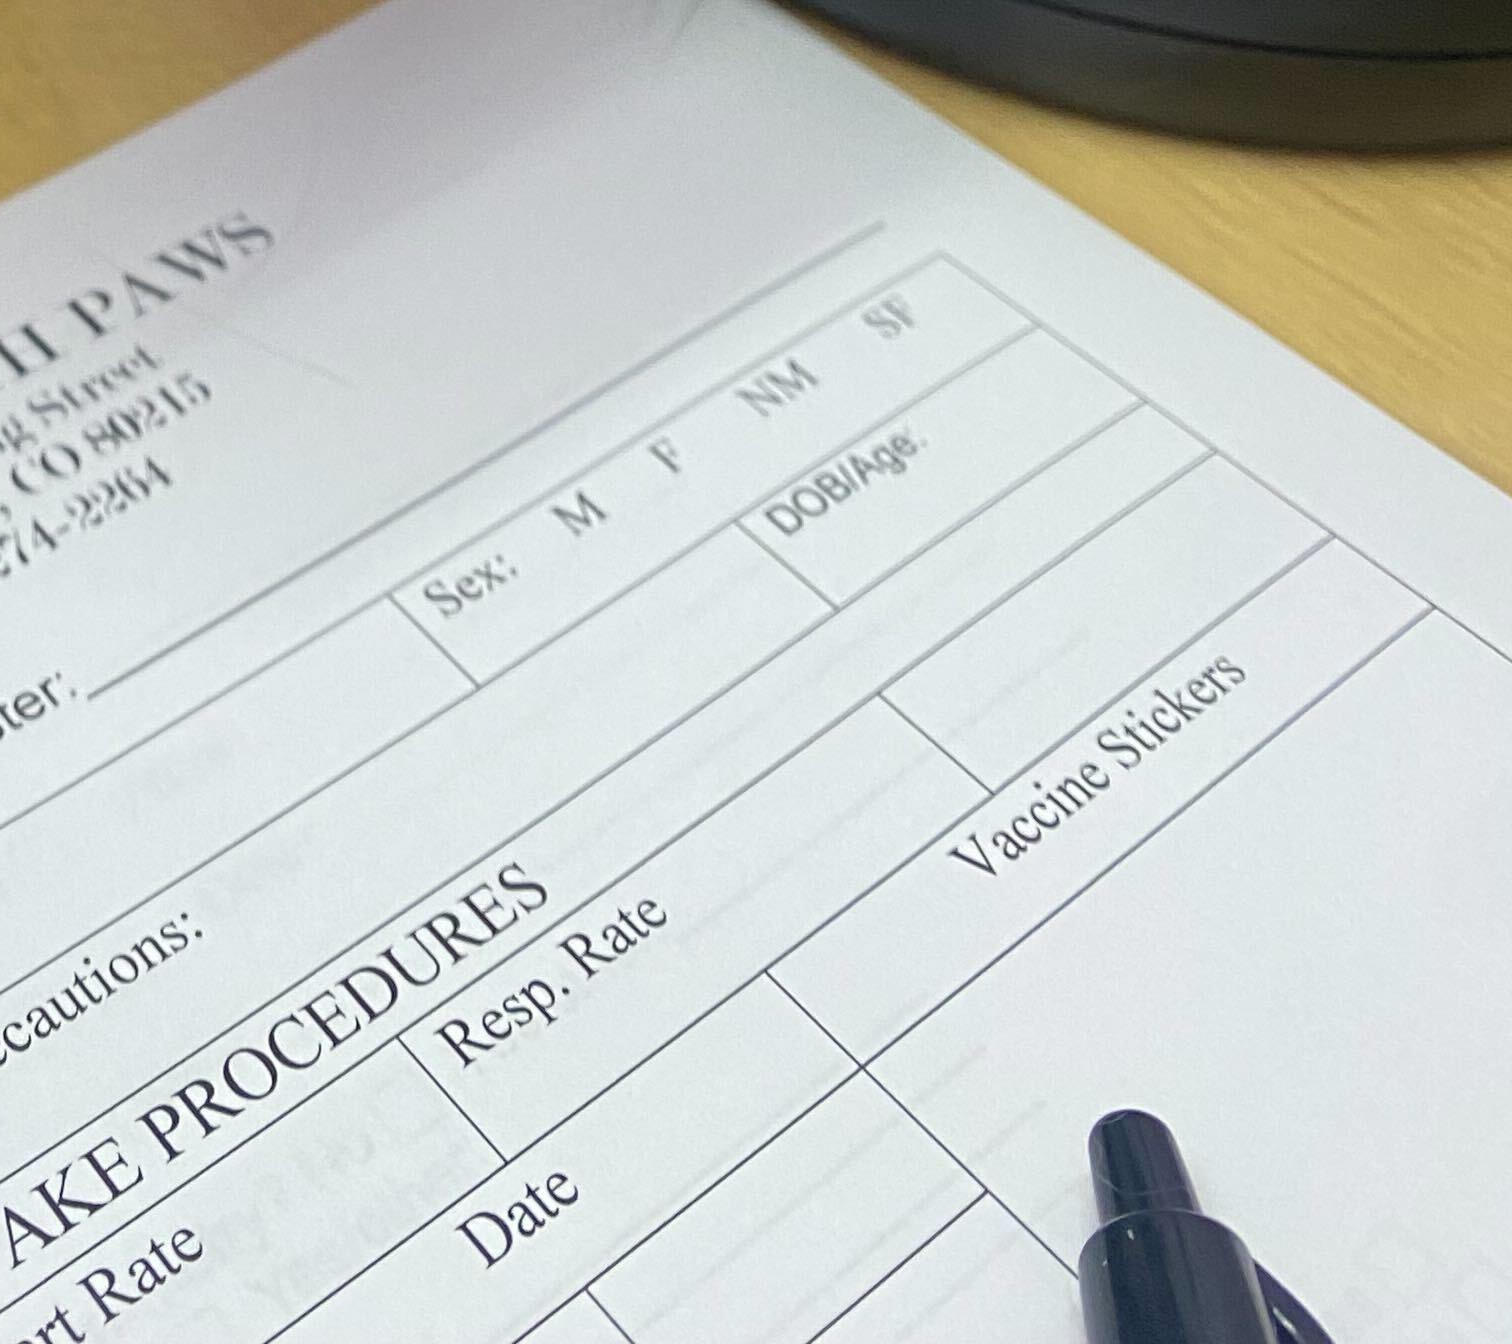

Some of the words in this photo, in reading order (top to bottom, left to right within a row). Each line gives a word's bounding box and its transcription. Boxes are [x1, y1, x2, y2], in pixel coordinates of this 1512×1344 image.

[67, 210, 276, 338] PAWS
[9, 441, 83, 497] CO
[83, 372, 213, 457] 80215
[26, 343, 164, 427] Street
[423, 554, 518, 619] Sex:
[550, 490, 607, 538] M
[648, 435, 682, 474] F
[736, 357, 819, 418] NM
[861, 292, 917, 341] SF
[765, 424, 927, 538] DOB/Age:
[948, 757, 1112, 882] Vaccine
[1096, 652, 1247, 772] Stickers
[136, 862, 549, 1163] PROCEDURES
[434, 972, 571, 1069] Resp.
[559, 895, 668, 982] Rate
[76, 1227, 203, 1324] Rate
[454, 1166, 578, 1270] Date
